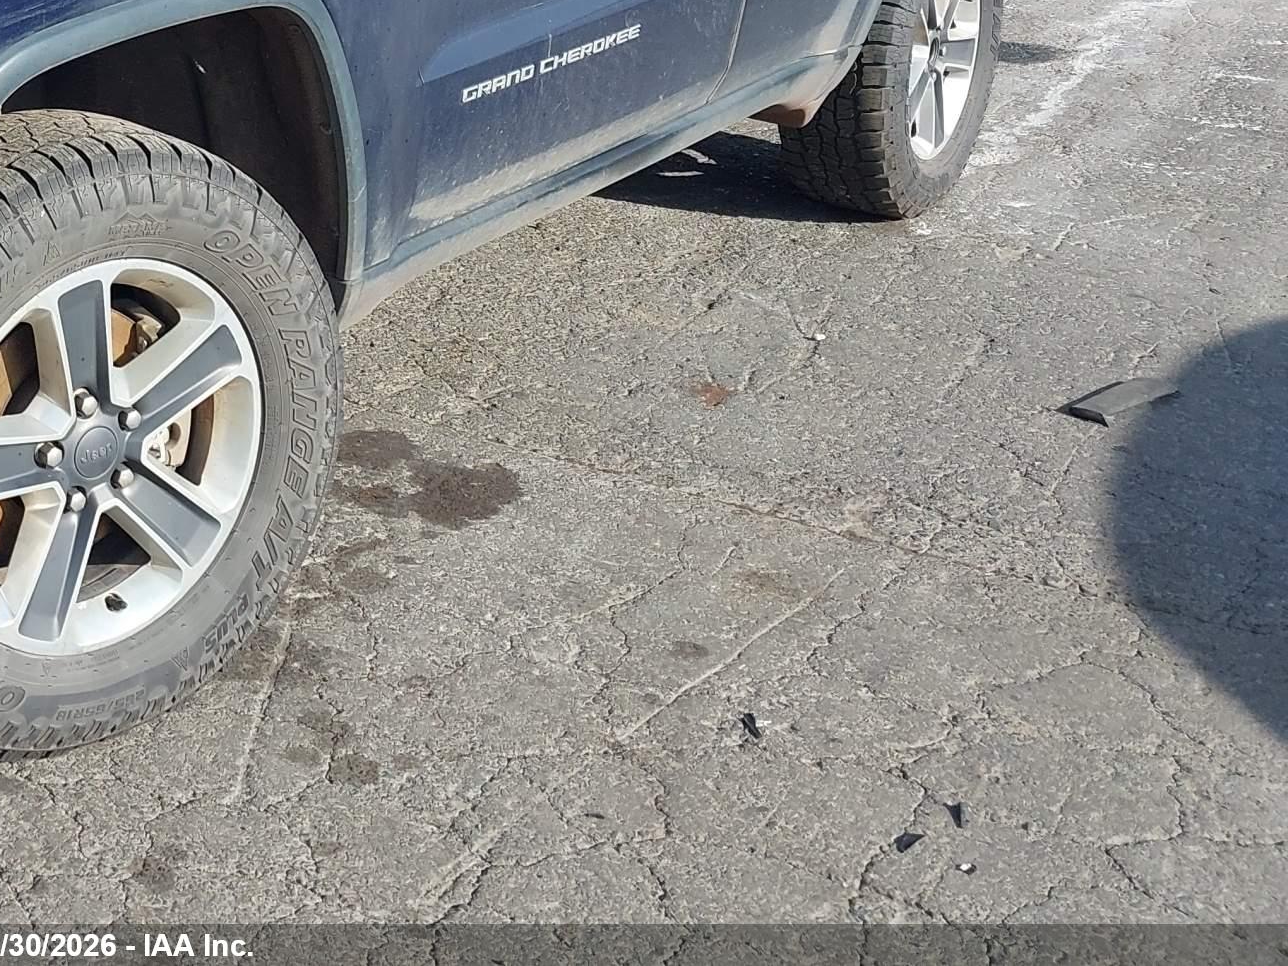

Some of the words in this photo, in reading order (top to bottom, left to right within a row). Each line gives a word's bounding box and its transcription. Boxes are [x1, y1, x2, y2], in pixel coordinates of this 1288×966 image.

[462, 64, 536, 104] GRAND
[539, 23, 642, 75] CHEROKEE
[202, 229, 300, 316] OPEN
[79, 442, 113, 465] Jeep
[278, 327, 318, 499] RANGE
[251, 493, 295, 593] A/T
